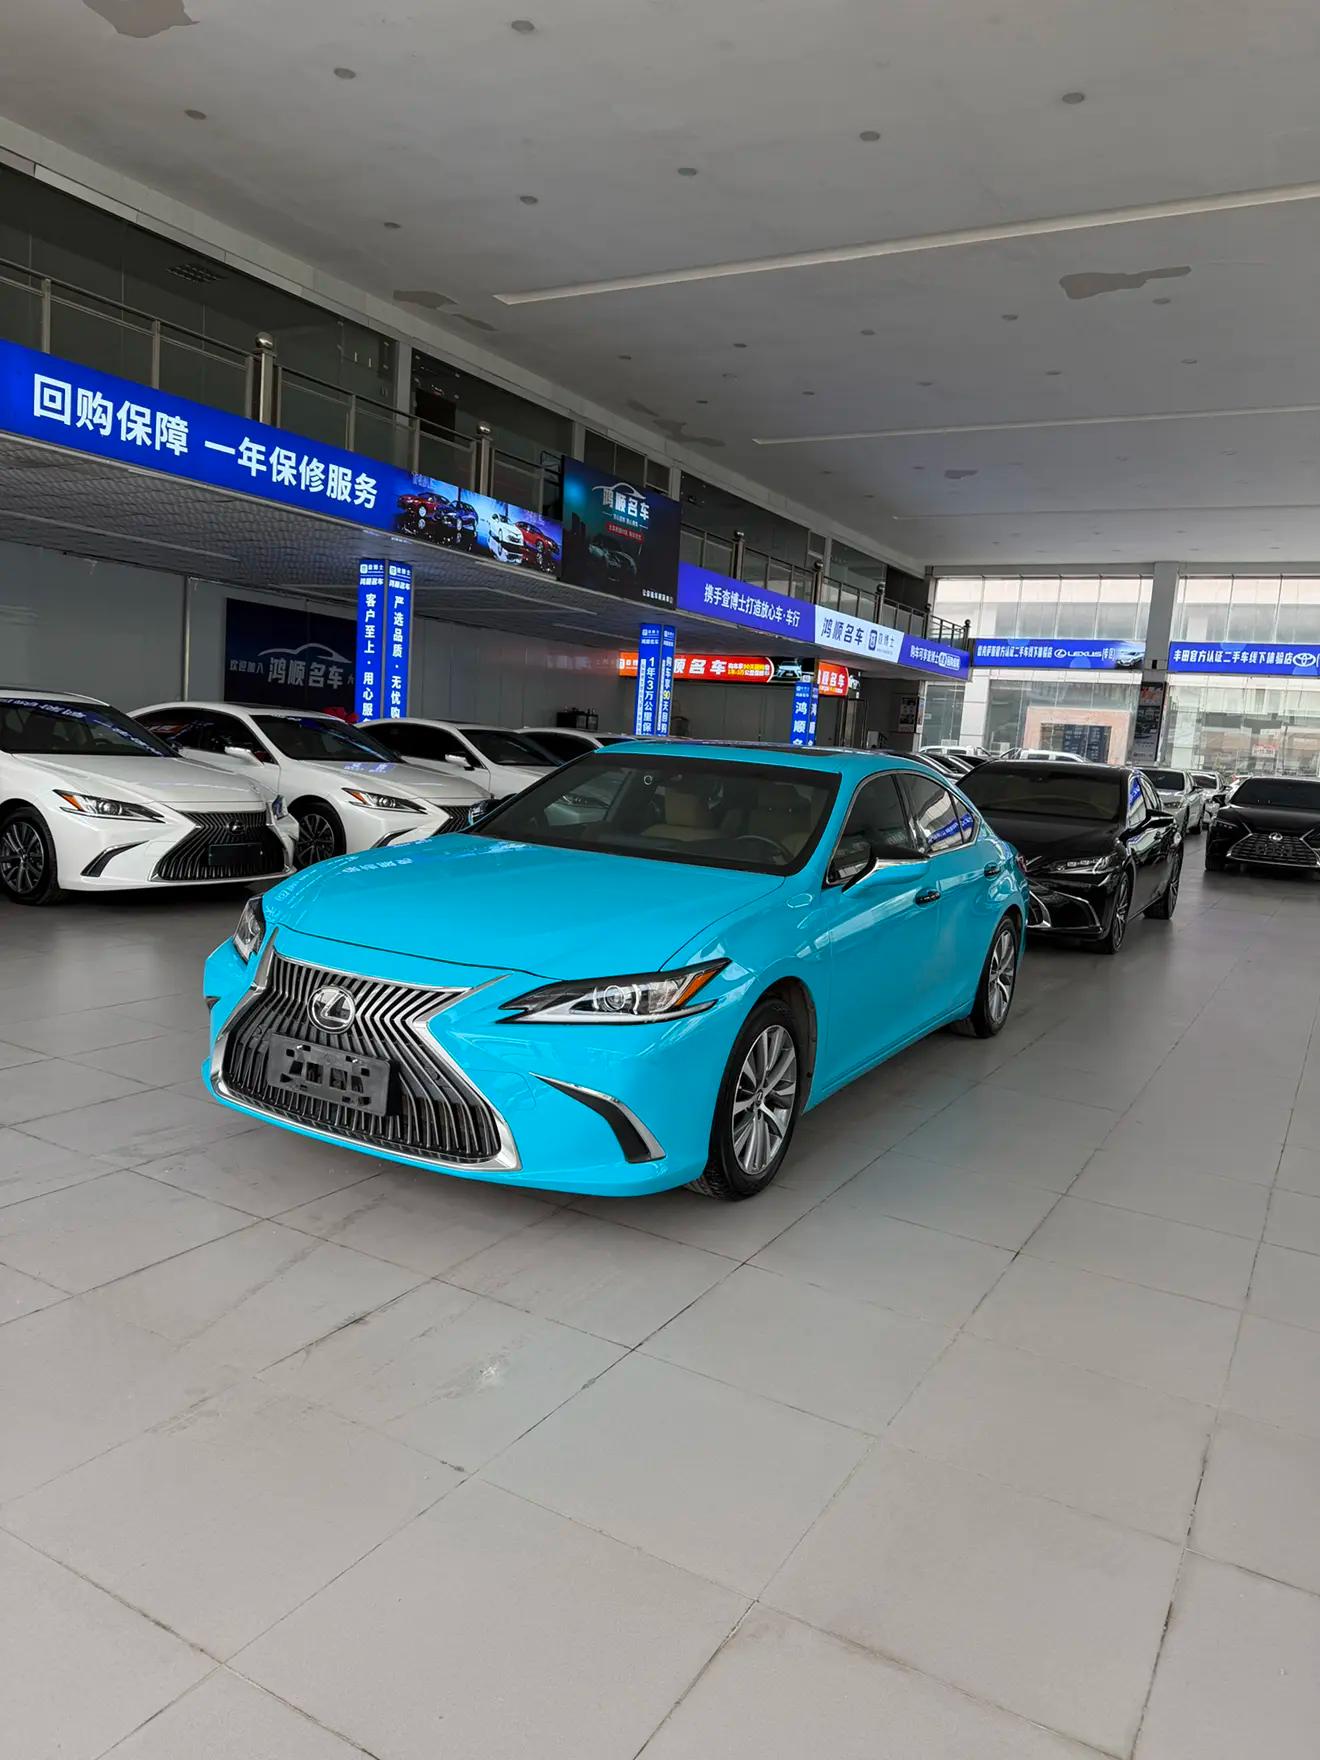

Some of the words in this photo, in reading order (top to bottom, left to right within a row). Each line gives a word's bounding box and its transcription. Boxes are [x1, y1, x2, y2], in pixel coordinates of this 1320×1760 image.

[33, 373, 189, 456] 回购保障
[204, 436, 379, 509] 一年保修服务
[602, 487, 650, 521] 鸿顺名车
[703, 583, 800, 627] 携手查博士打造放心车·车行
[820, 616, 864, 646] 鸿顺名车
[267, 657, 343, 690] 鸿顺名车
[362, 593, 377, 722] 客户至上·用心服
[1173, 649, 1294, 666] 丰田官方认证二手车线下体验店
[642, 656, 656, 737] 1年/3万公里保
